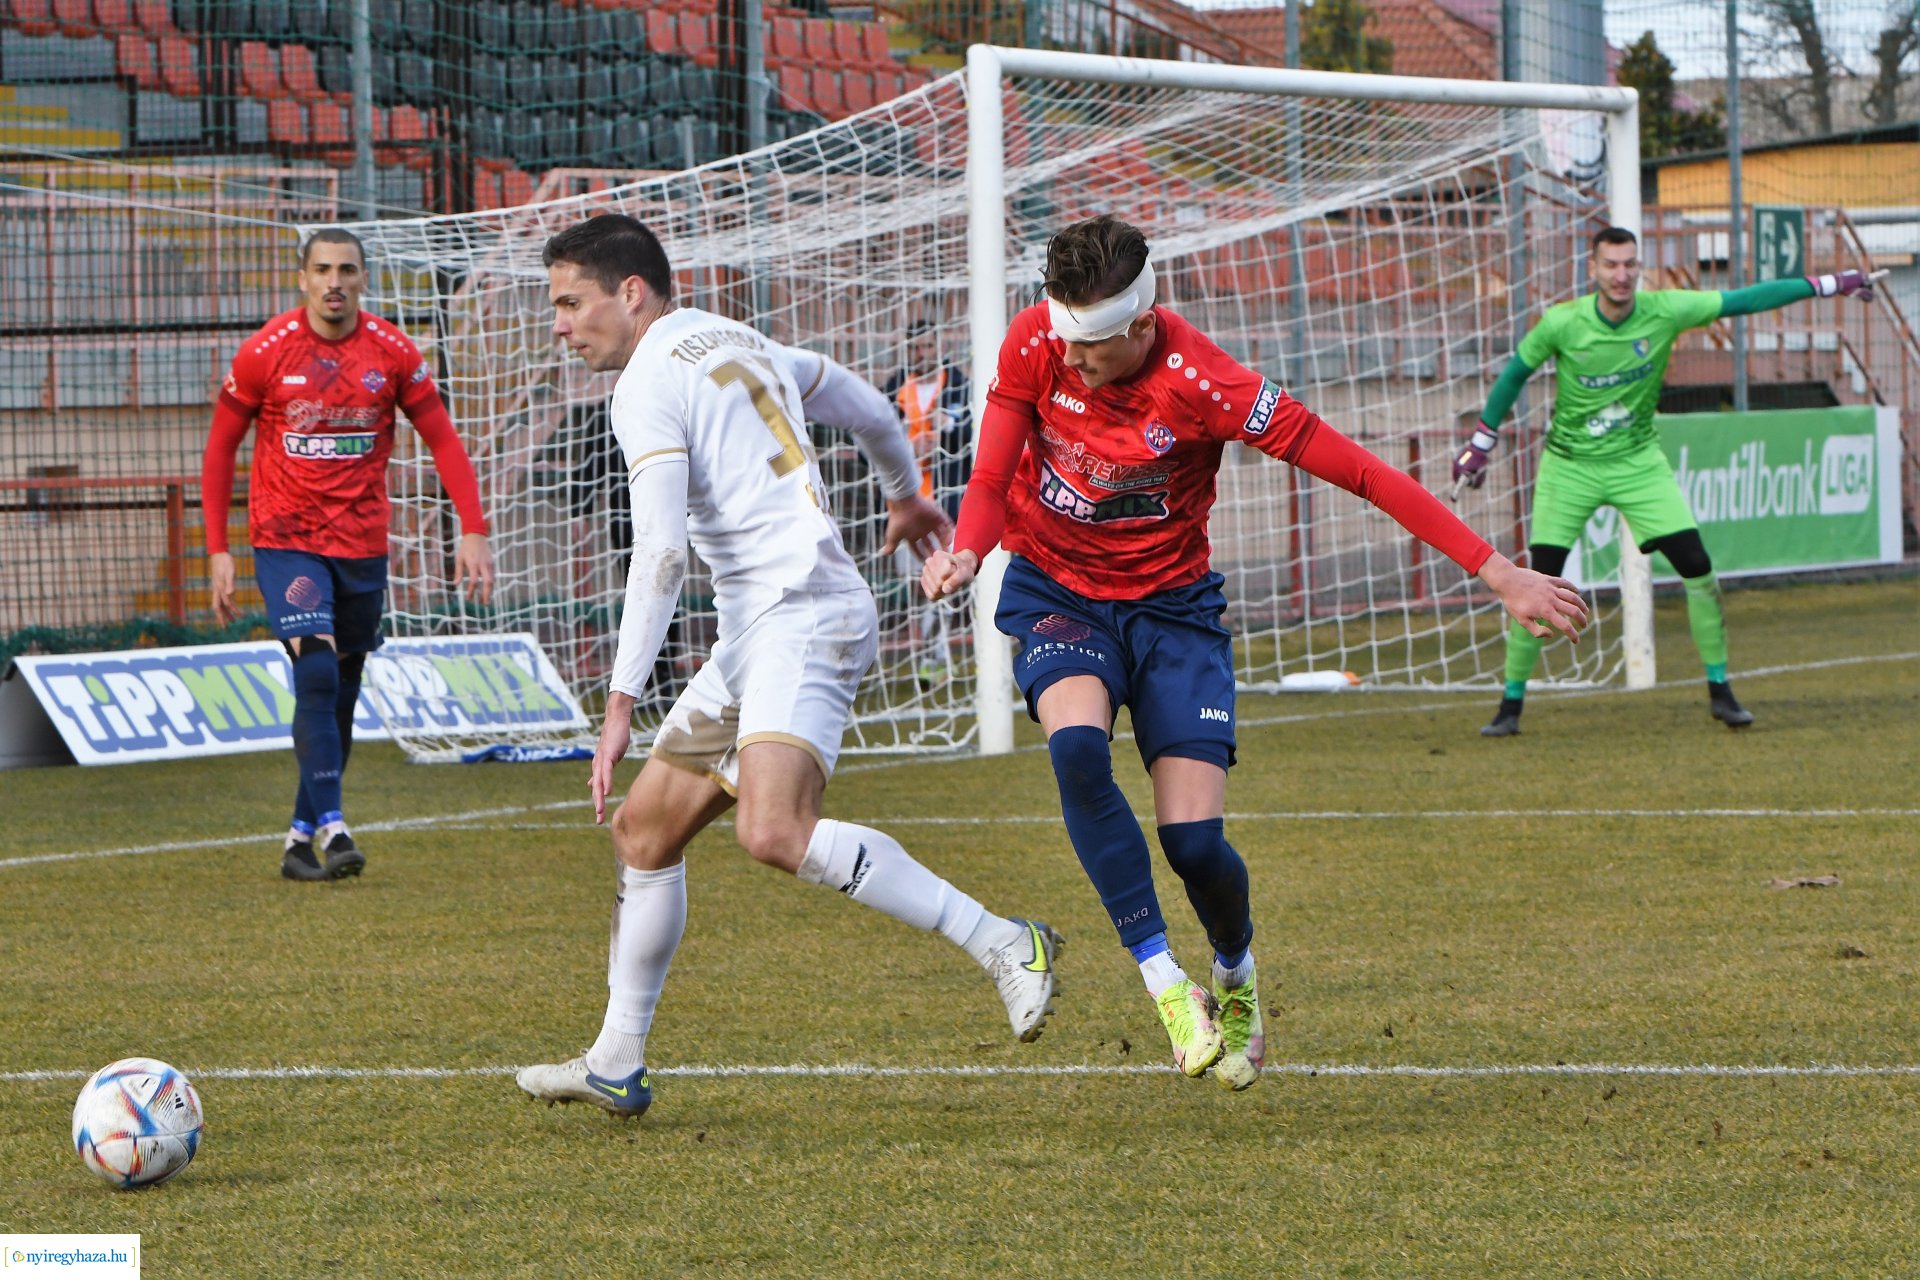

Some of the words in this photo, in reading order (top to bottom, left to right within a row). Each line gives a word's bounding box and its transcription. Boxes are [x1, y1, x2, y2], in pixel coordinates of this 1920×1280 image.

[1051, 391, 1086, 414] JAKO
[1675, 438, 1818, 523] kantilbank
[1825, 452, 1869, 496] LIGA
[1026, 642, 1107, 663] PRESTIGE
[1199, 707, 1229, 723] JAKO
[1117, 906, 1150, 928] JAKO
